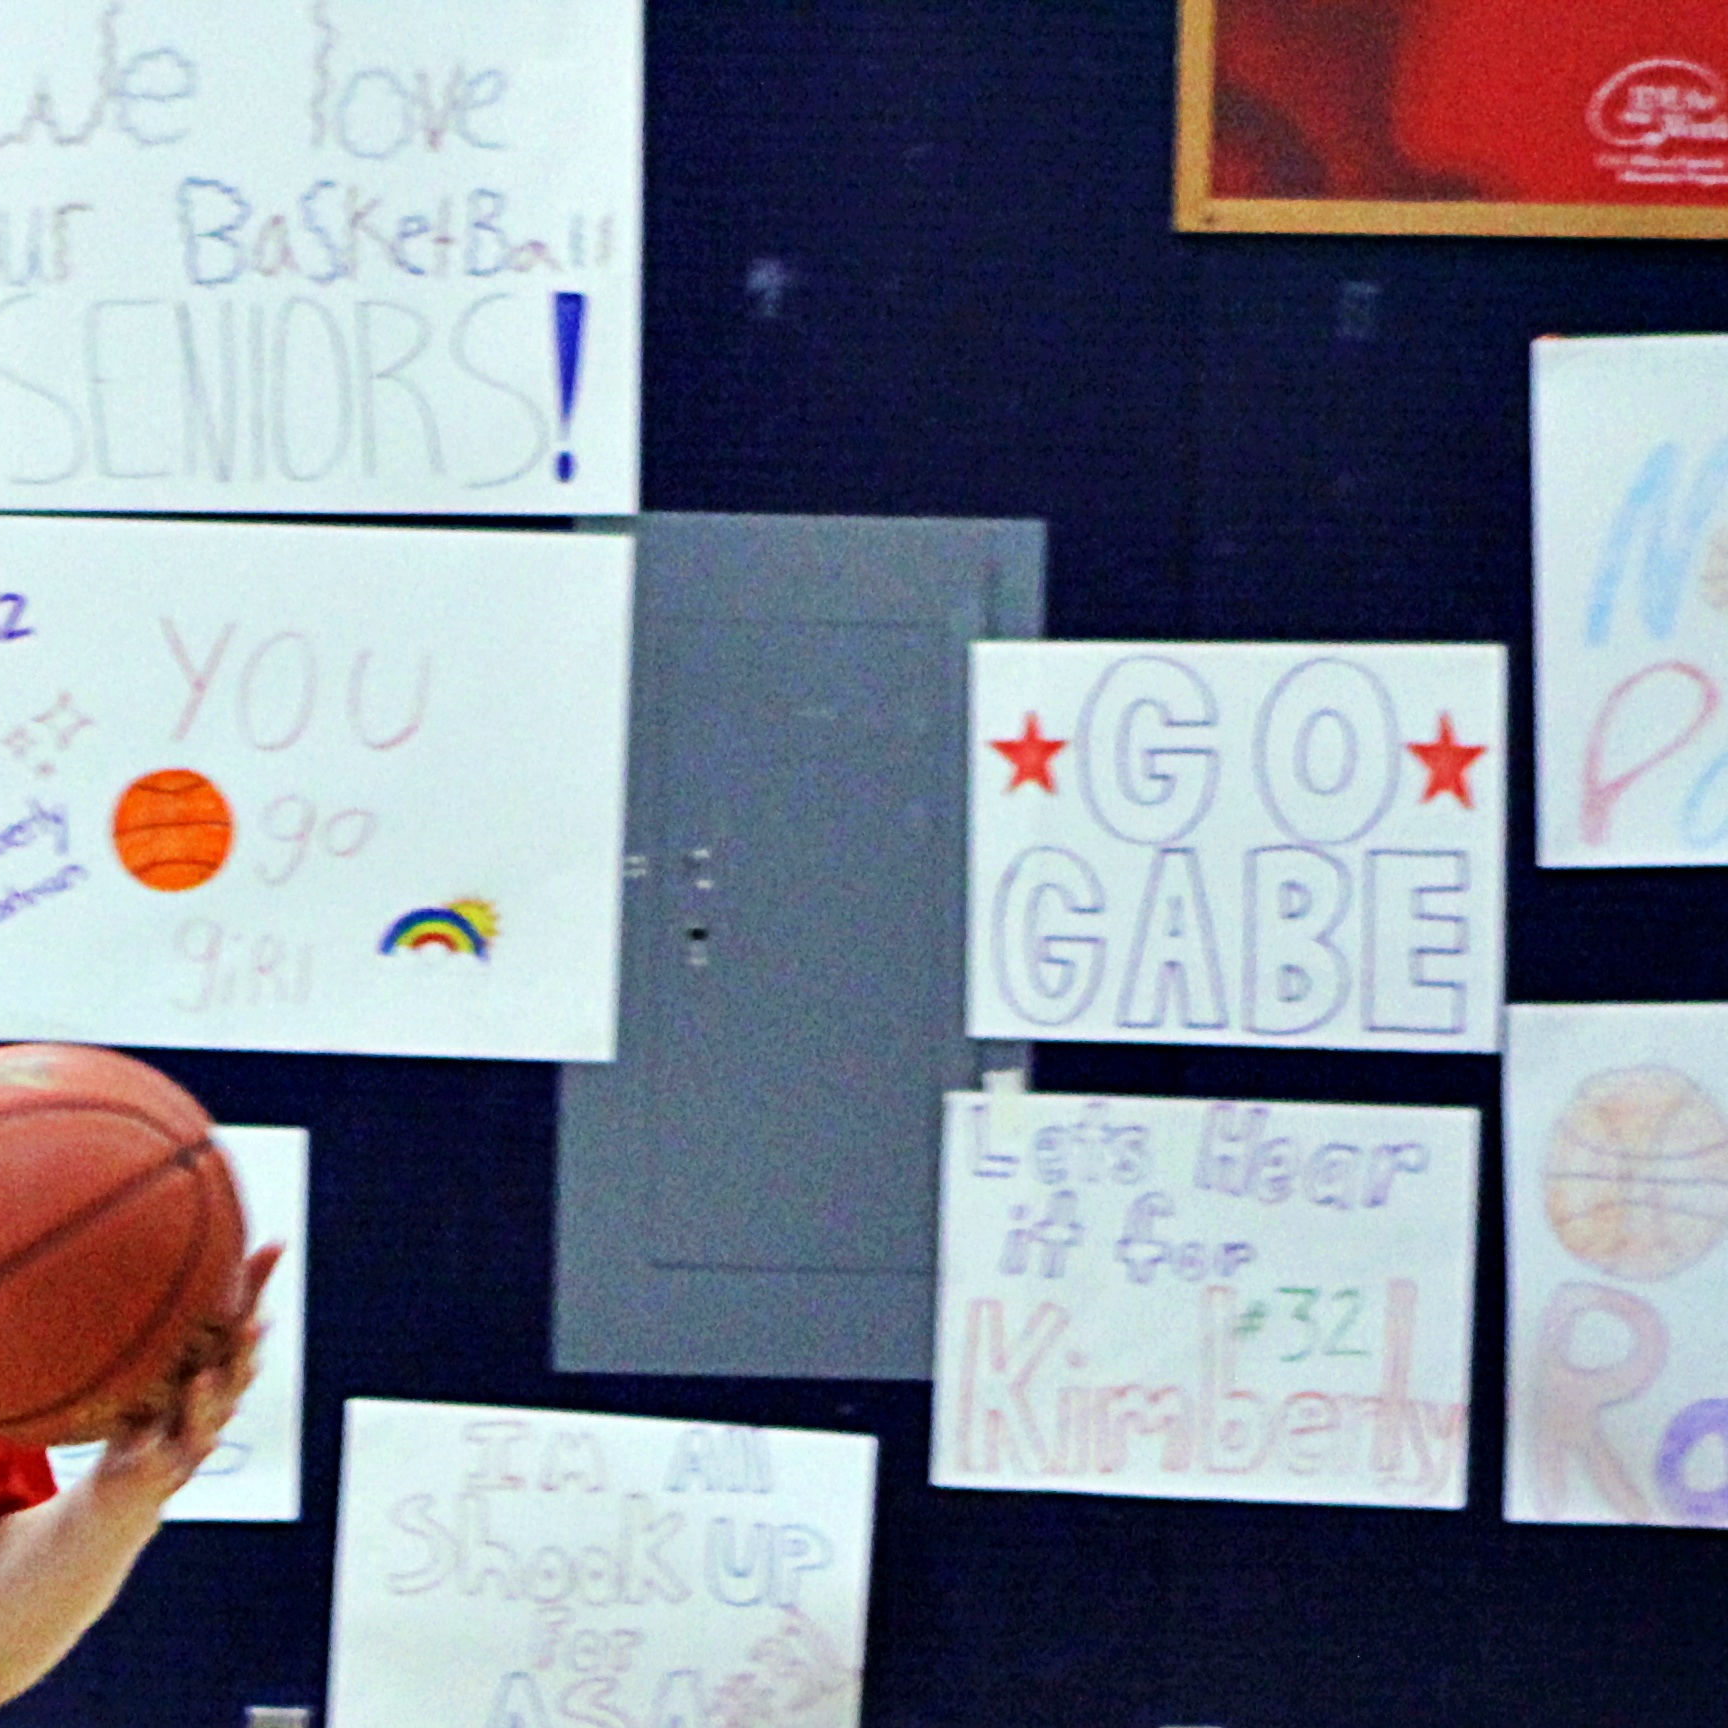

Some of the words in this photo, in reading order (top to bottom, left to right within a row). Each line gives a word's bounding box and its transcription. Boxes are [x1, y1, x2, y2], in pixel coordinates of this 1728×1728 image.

[158, 614, 435, 753] YOU
[1075, 653, 1403, 847] GO
[990, 844, 1475, 1037] GABE
